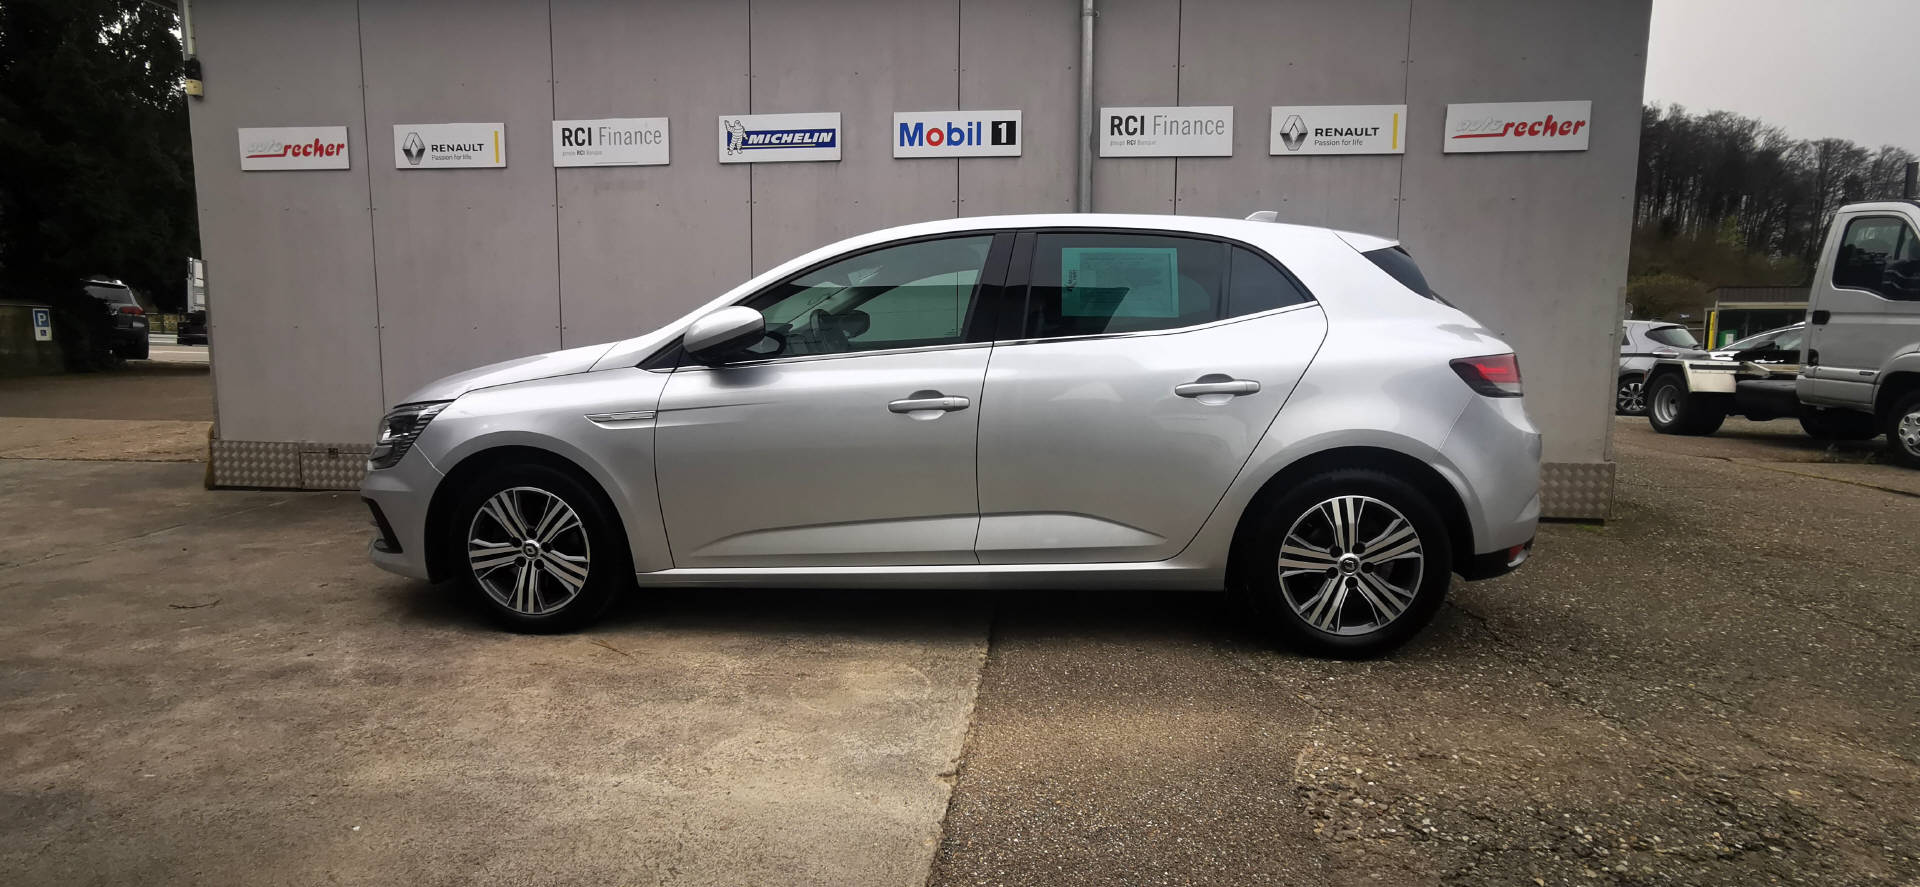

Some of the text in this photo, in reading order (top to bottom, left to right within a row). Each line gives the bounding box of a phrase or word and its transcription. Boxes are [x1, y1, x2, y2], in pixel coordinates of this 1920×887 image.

[1110, 114, 1225, 136] RCI Finance
[1314, 127, 1380, 137] RENAULT
[1502, 114, 1586, 138] recher
[561, 126, 662, 147] RCI Finance
[747, 132, 833, 145] MICHELIN
[899, 121, 982, 147] Mobil
[283, 137, 345, 158] recher
[431, 143, 484, 152] RENAULT
[1314, 139, 1340, 147] Passion
[37, 312, 47, 326] P
